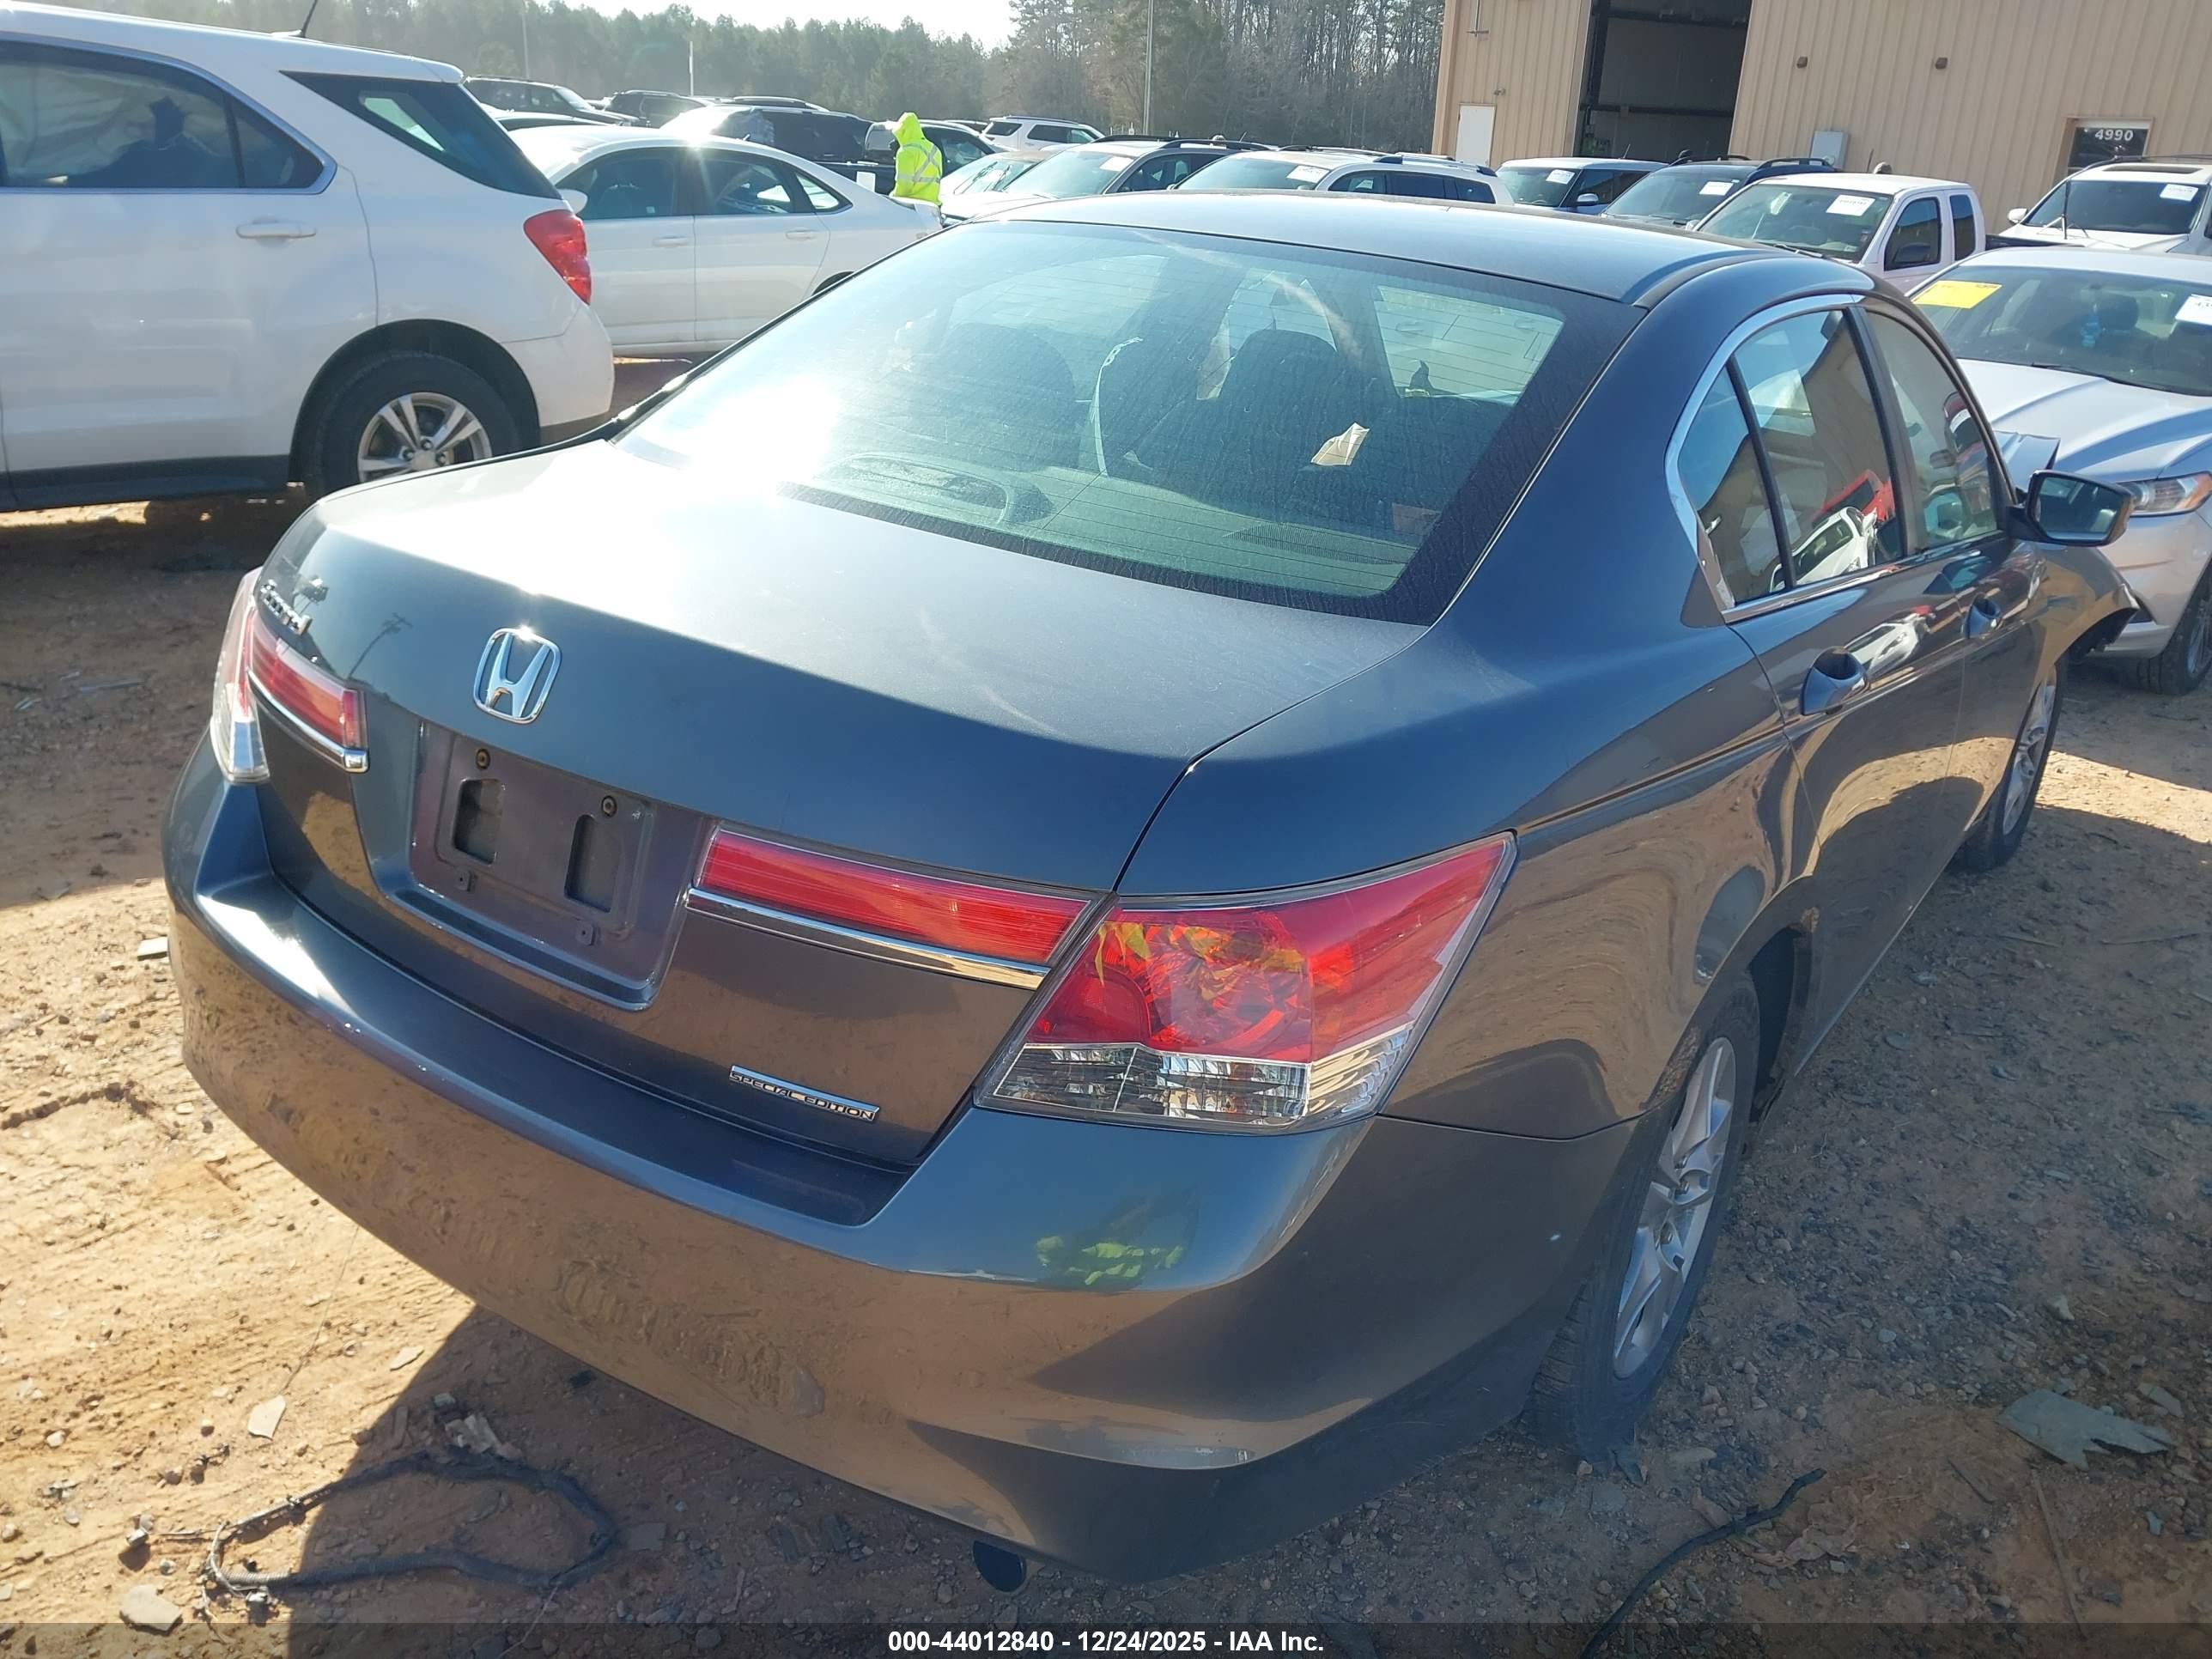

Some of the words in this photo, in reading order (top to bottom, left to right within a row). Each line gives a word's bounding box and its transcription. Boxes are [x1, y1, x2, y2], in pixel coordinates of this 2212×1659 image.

[2095, 129, 2134, 141] 4990
[730, 1073, 803, 1101] SPECIAL
[804, 1096, 876, 1121] EDITION
